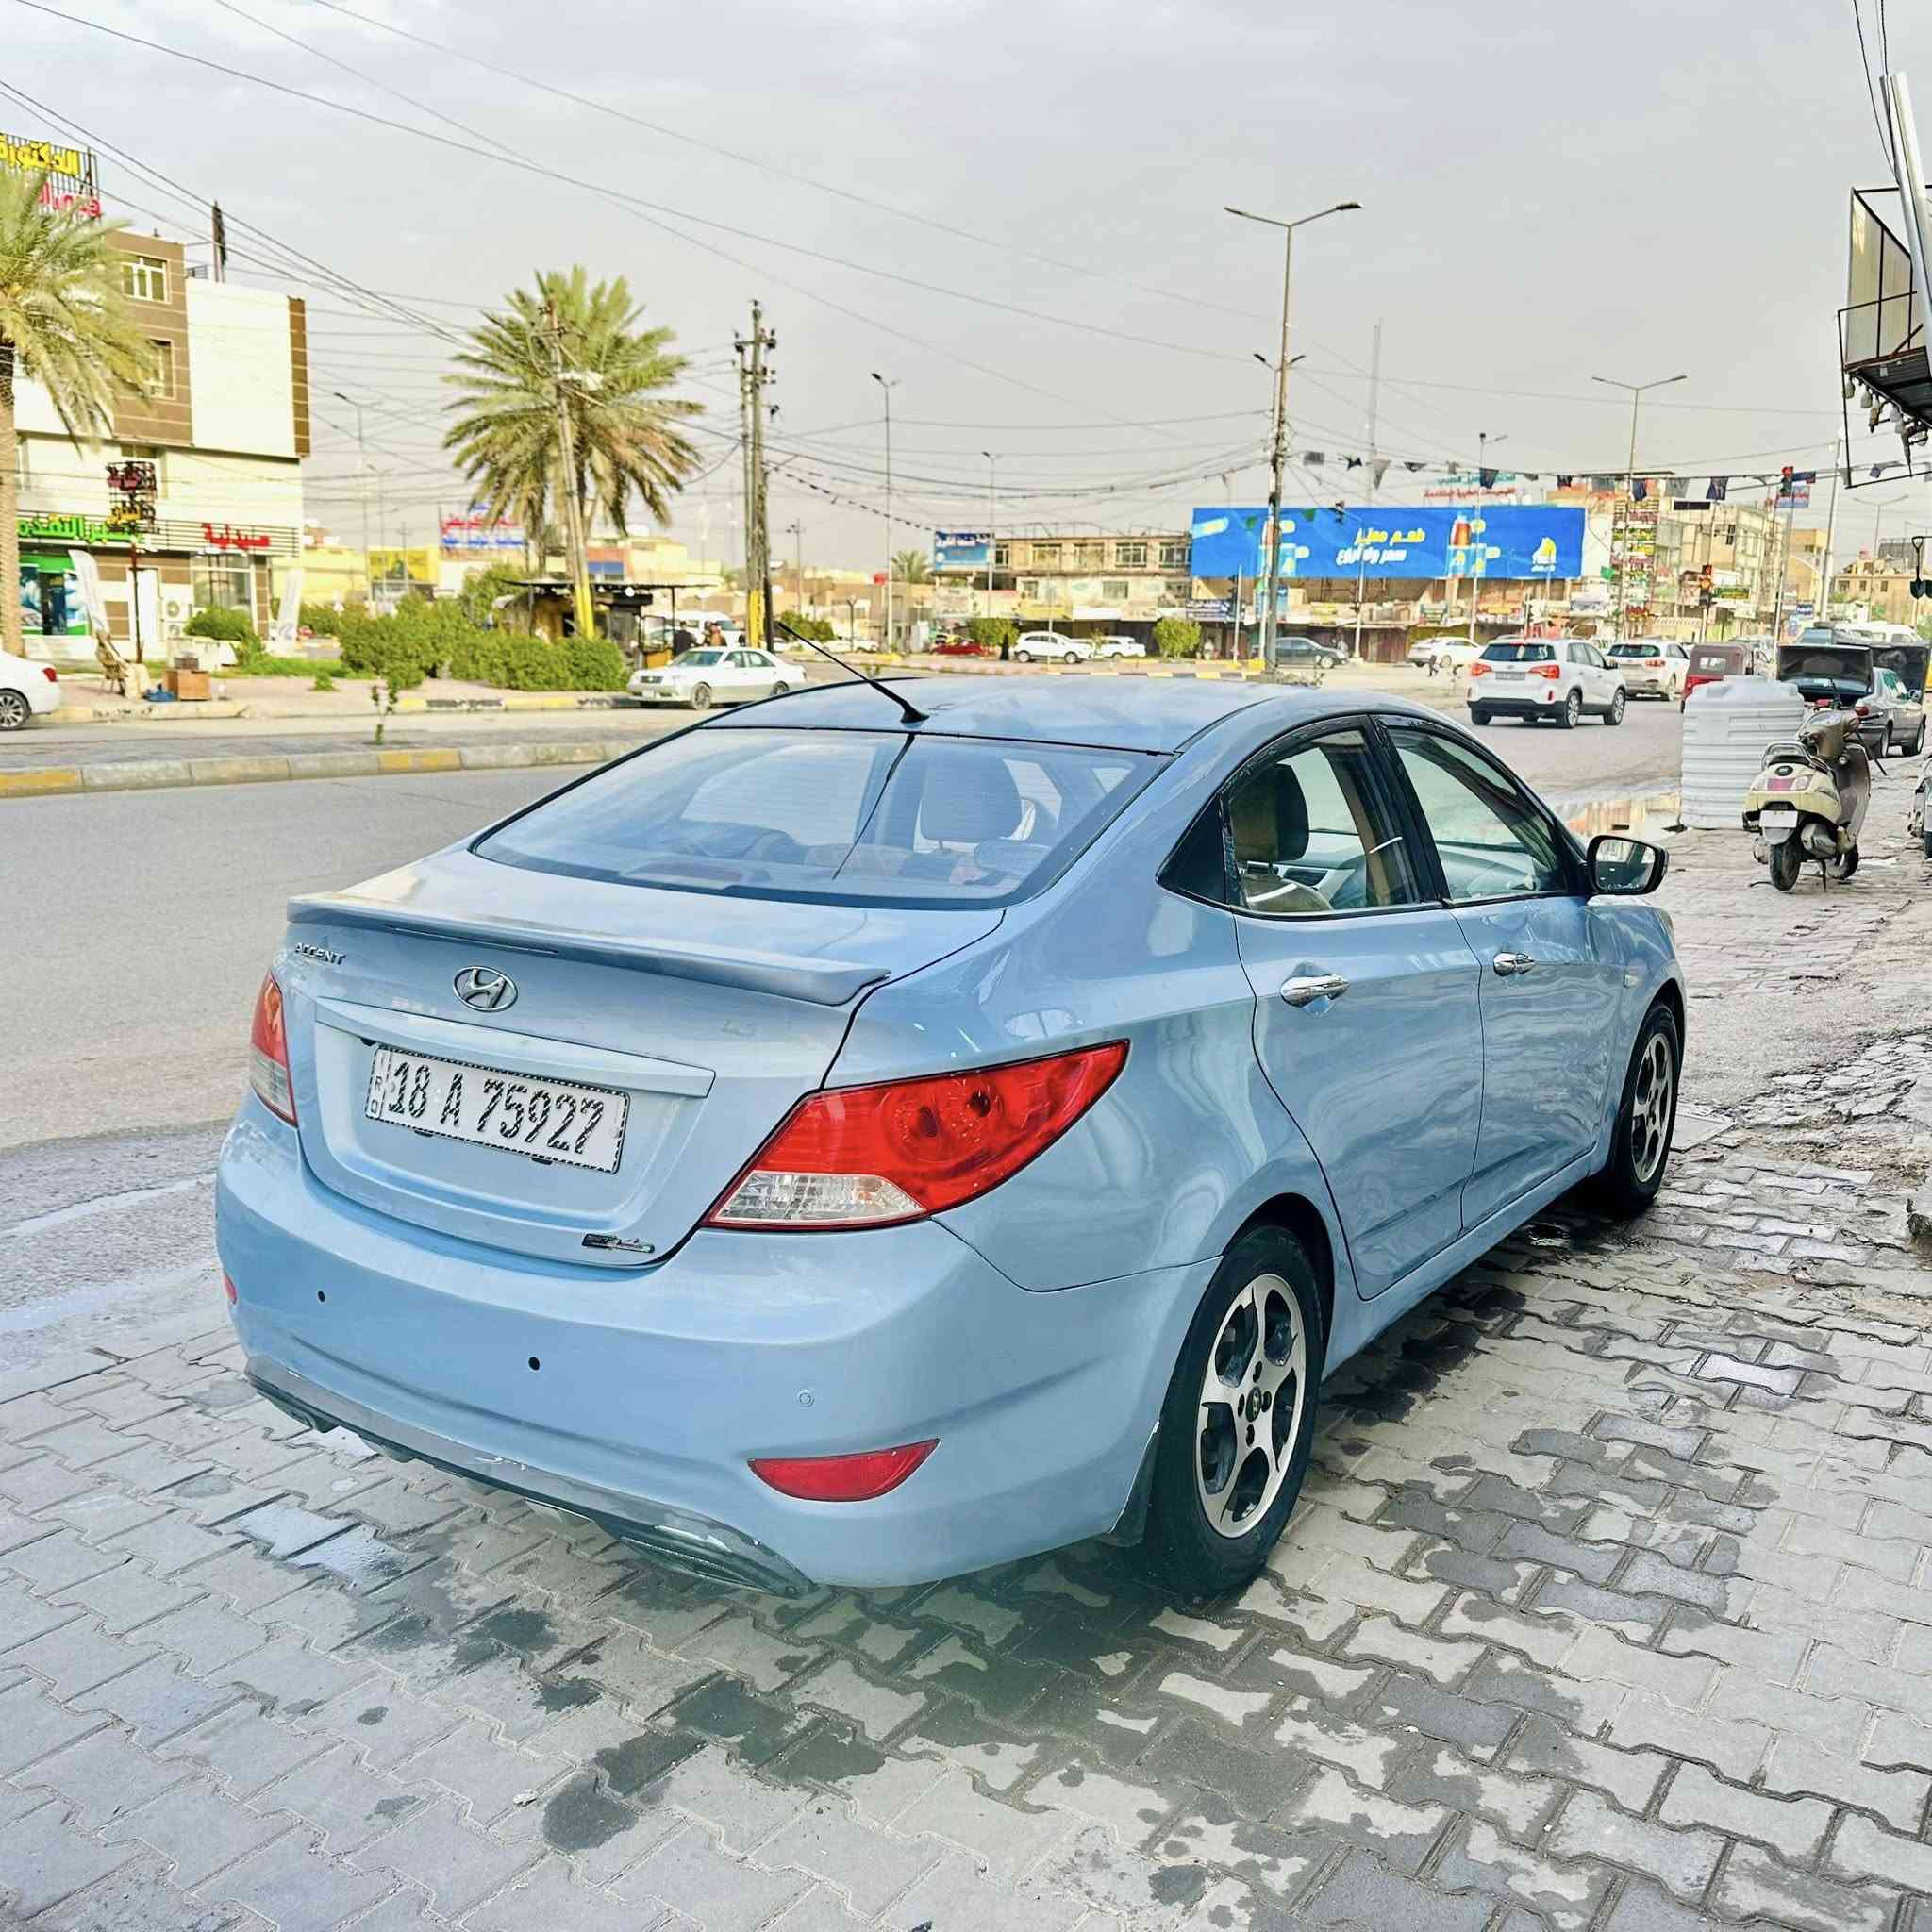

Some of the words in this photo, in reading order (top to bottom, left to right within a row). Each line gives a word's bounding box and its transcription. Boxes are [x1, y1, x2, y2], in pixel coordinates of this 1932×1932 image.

[294, 942, 347, 966] ACCENT
[388, 1062, 431, 1118] 18
[440, 1072, 463, 1127] A
[476, 1078, 605, 1155] 75927
